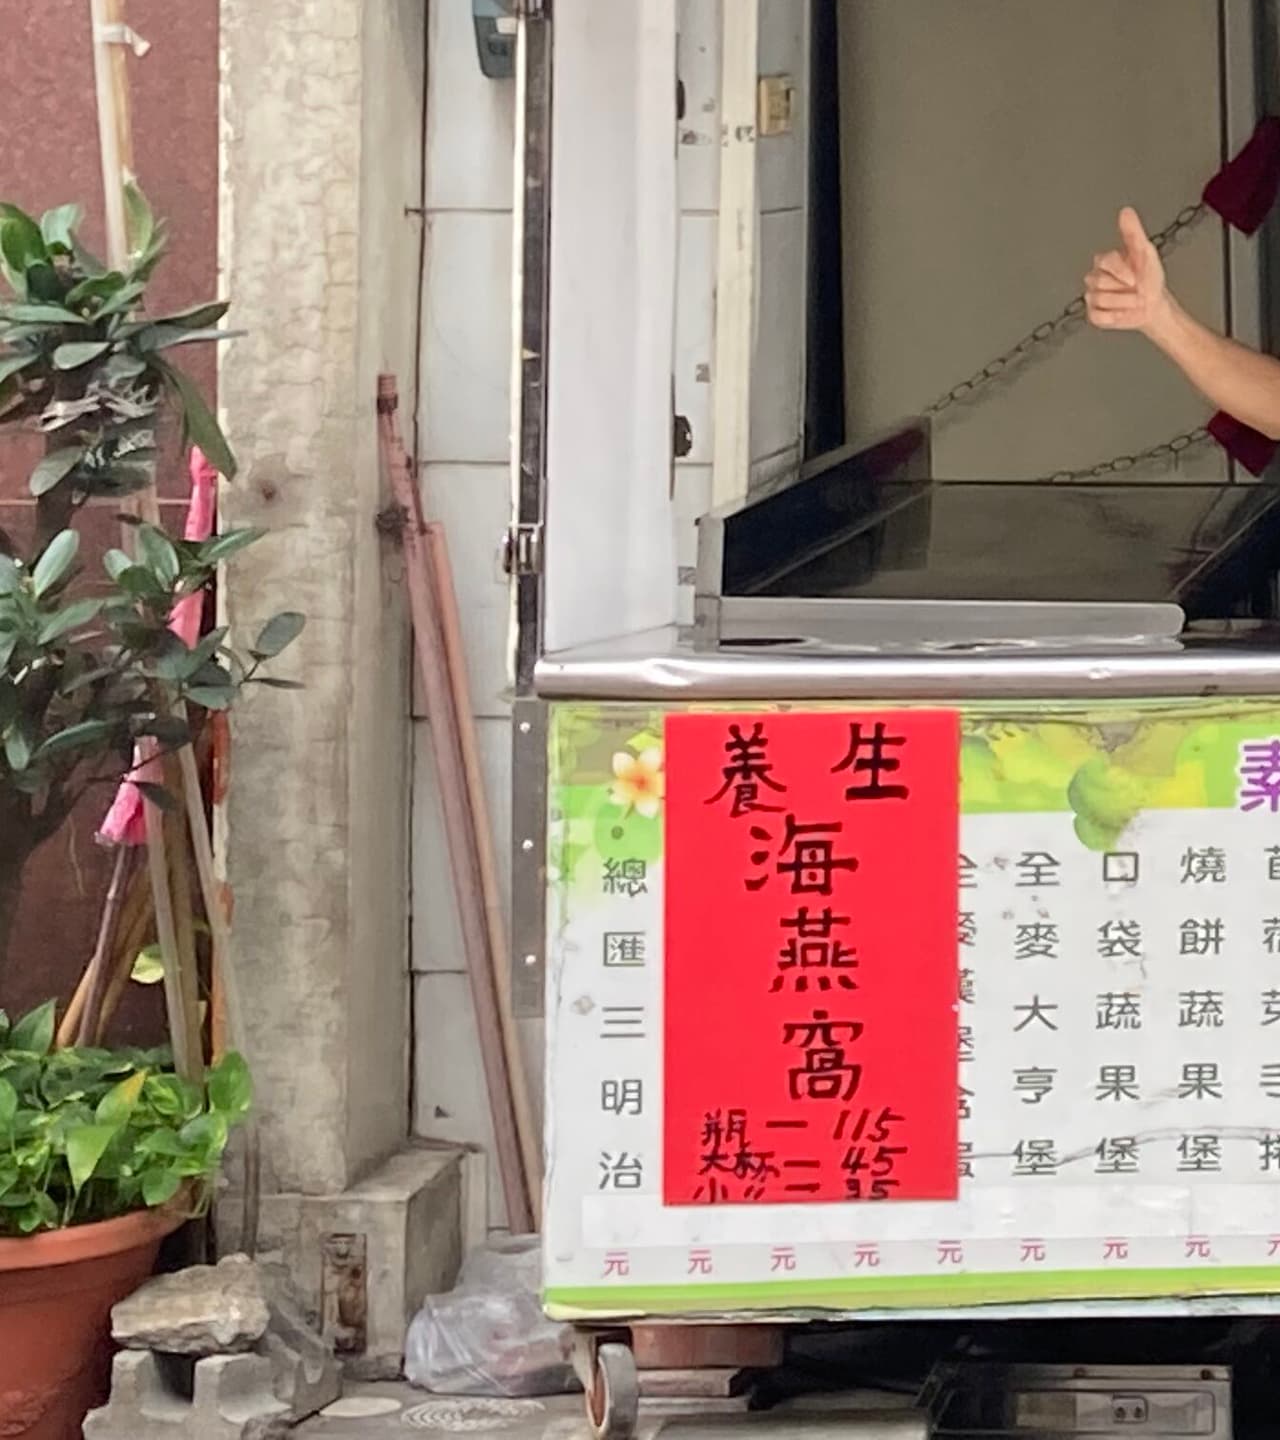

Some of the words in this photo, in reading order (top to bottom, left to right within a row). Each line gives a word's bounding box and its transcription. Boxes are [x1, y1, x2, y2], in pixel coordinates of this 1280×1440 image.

[704, 720, 909, 818] 養生
[599, 856, 648, 1191] 總匯三明治
[743, 813, 865, 1102] 海燕窩
[1012, 851, 1061, 1177] 全麥大亨堡
[1093, 850, 1142, 1175] 口袋蔬果堡
[1176, 846, 1227, 1173] 燒餅蔬果堡
[604, 1251, 629, 1276] 元
[688, 1248, 713, 1274] 元
[770, 1246, 796, 1272] 元
[854, 1243, 880, 1268] 元
[937, 1240, 963, 1265] 元
[1020, 1239, 1046, 1262] 元
[1103, 1237, 1129, 1260] 元
[1185, 1236, 1211, 1259] 元
[840, 1146, 908, 1177] 45
